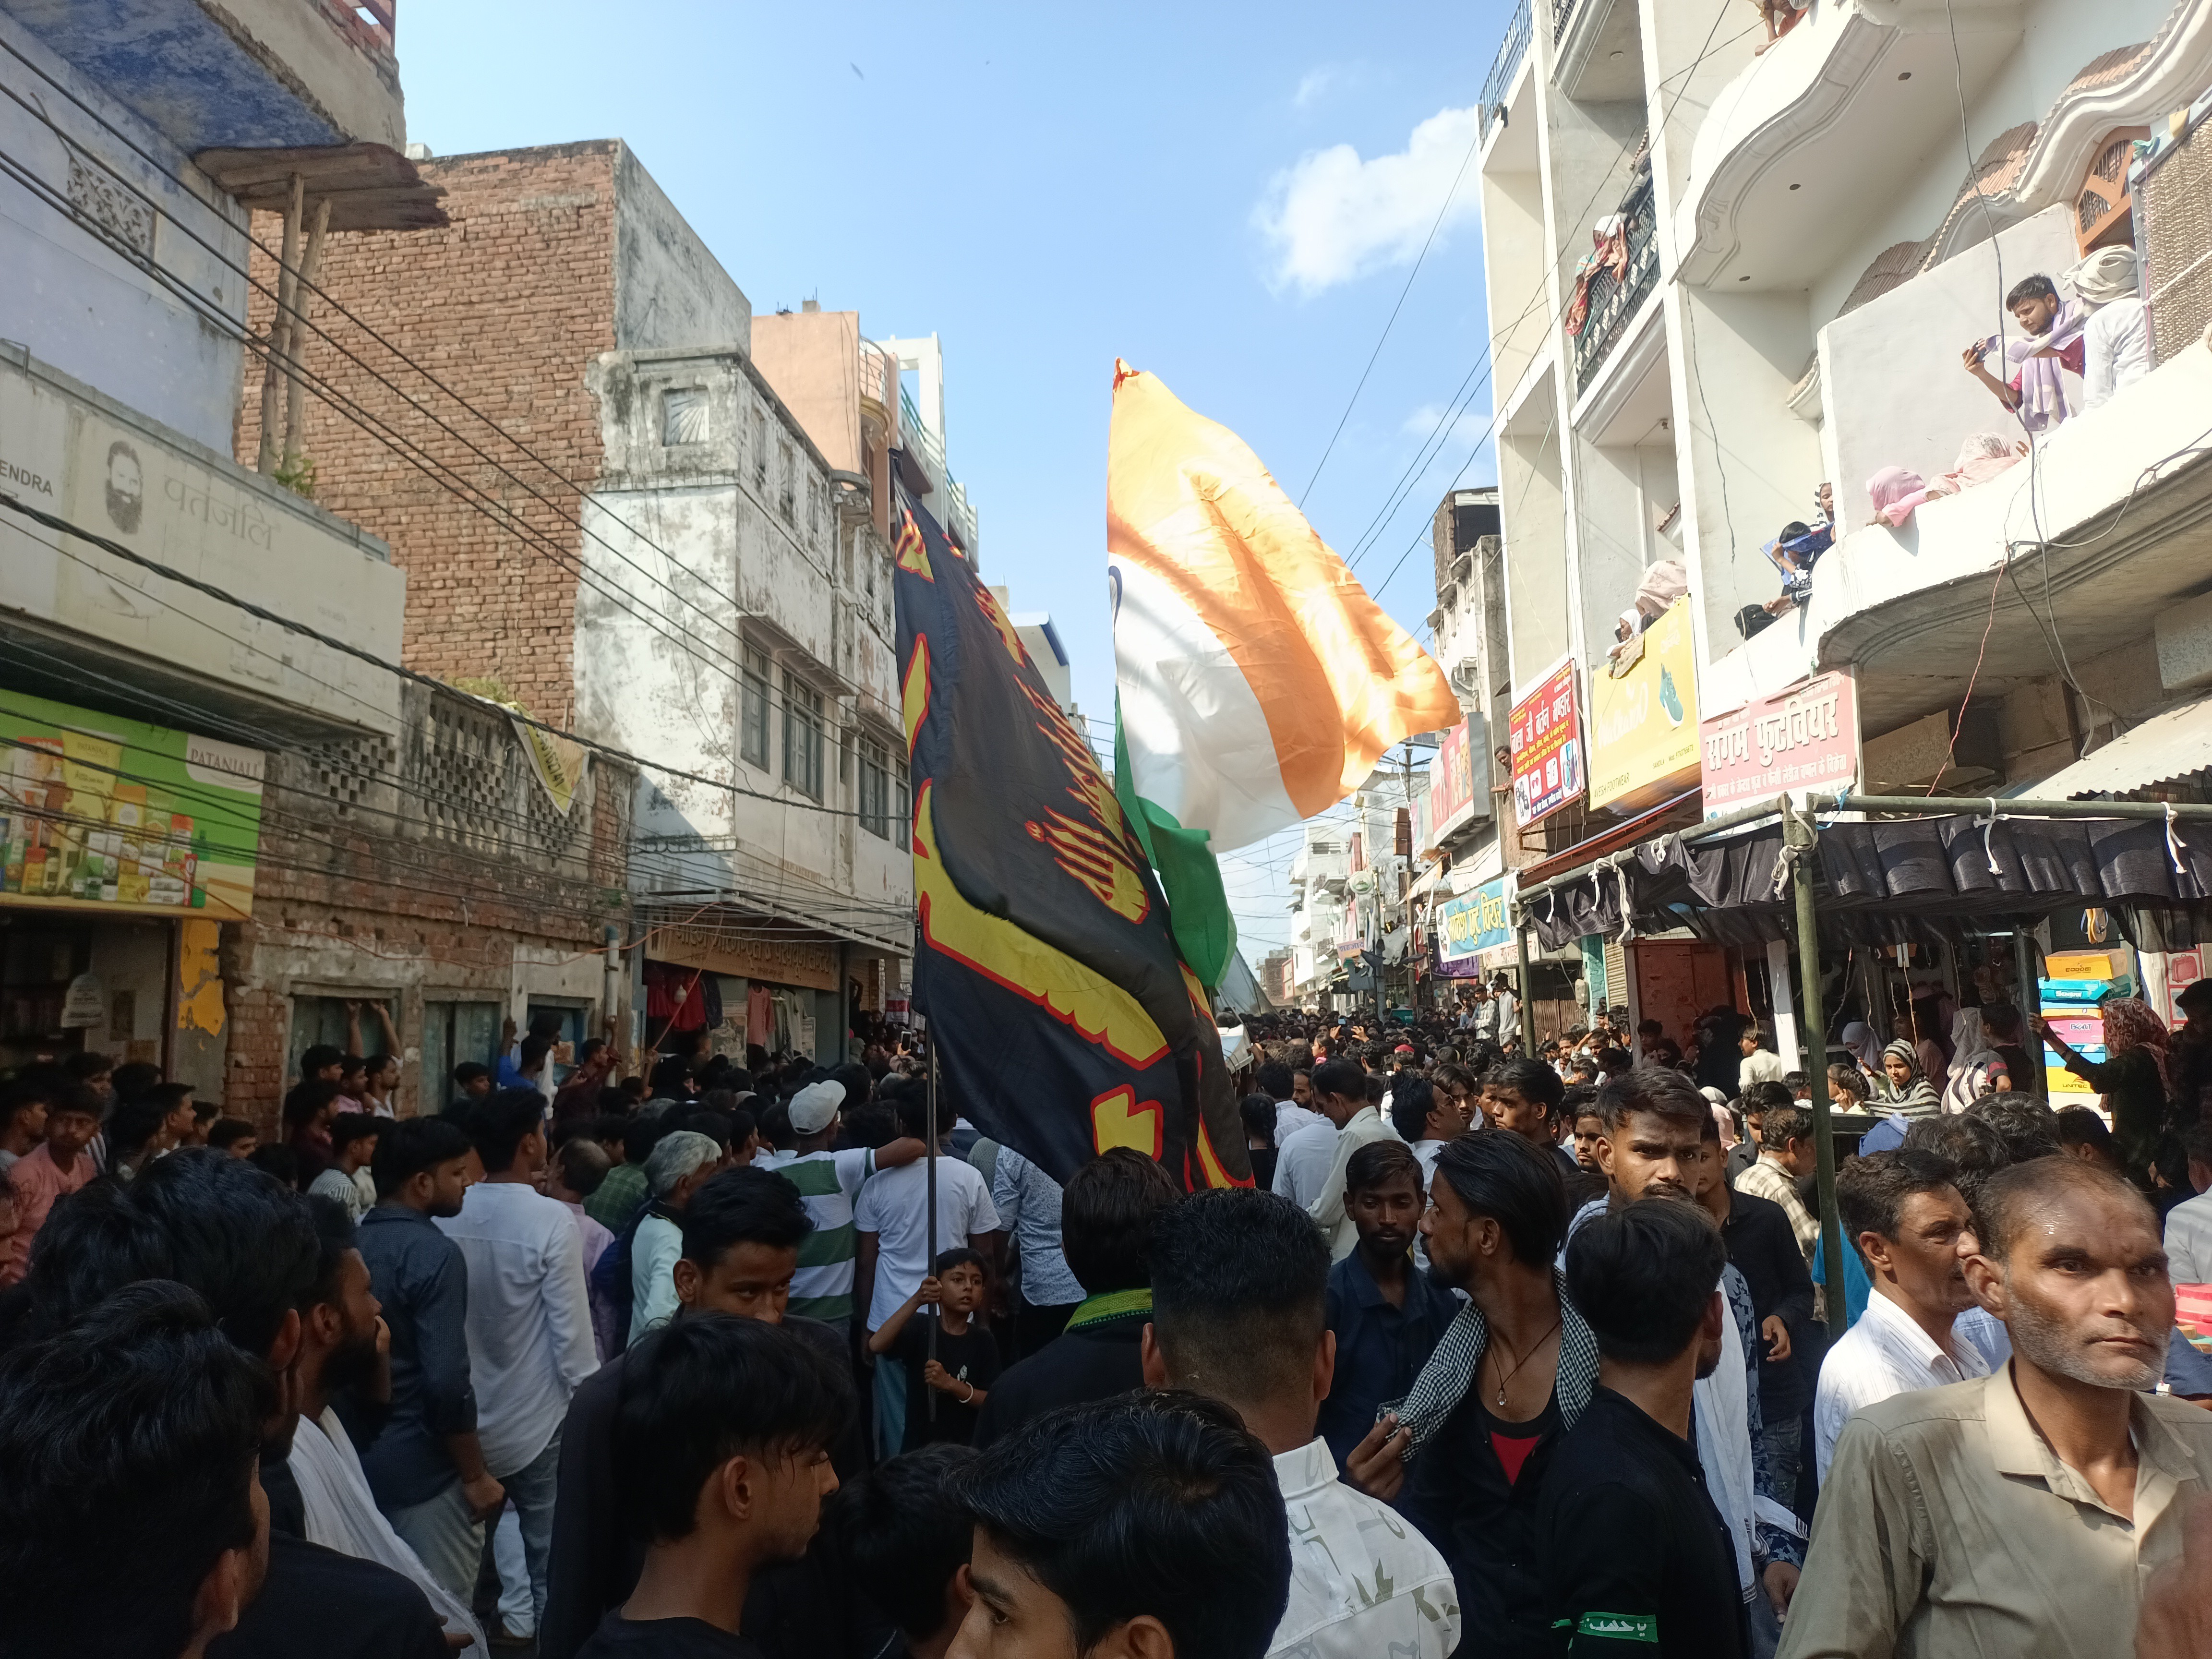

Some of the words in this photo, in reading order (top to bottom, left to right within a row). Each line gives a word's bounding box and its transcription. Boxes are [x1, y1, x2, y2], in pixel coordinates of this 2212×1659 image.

[164, 475, 276, 550] पतंजलि
[1536, 700, 1550, 735] बर्तन
[1607, 772, 1629, 792] FOOTWEAR
